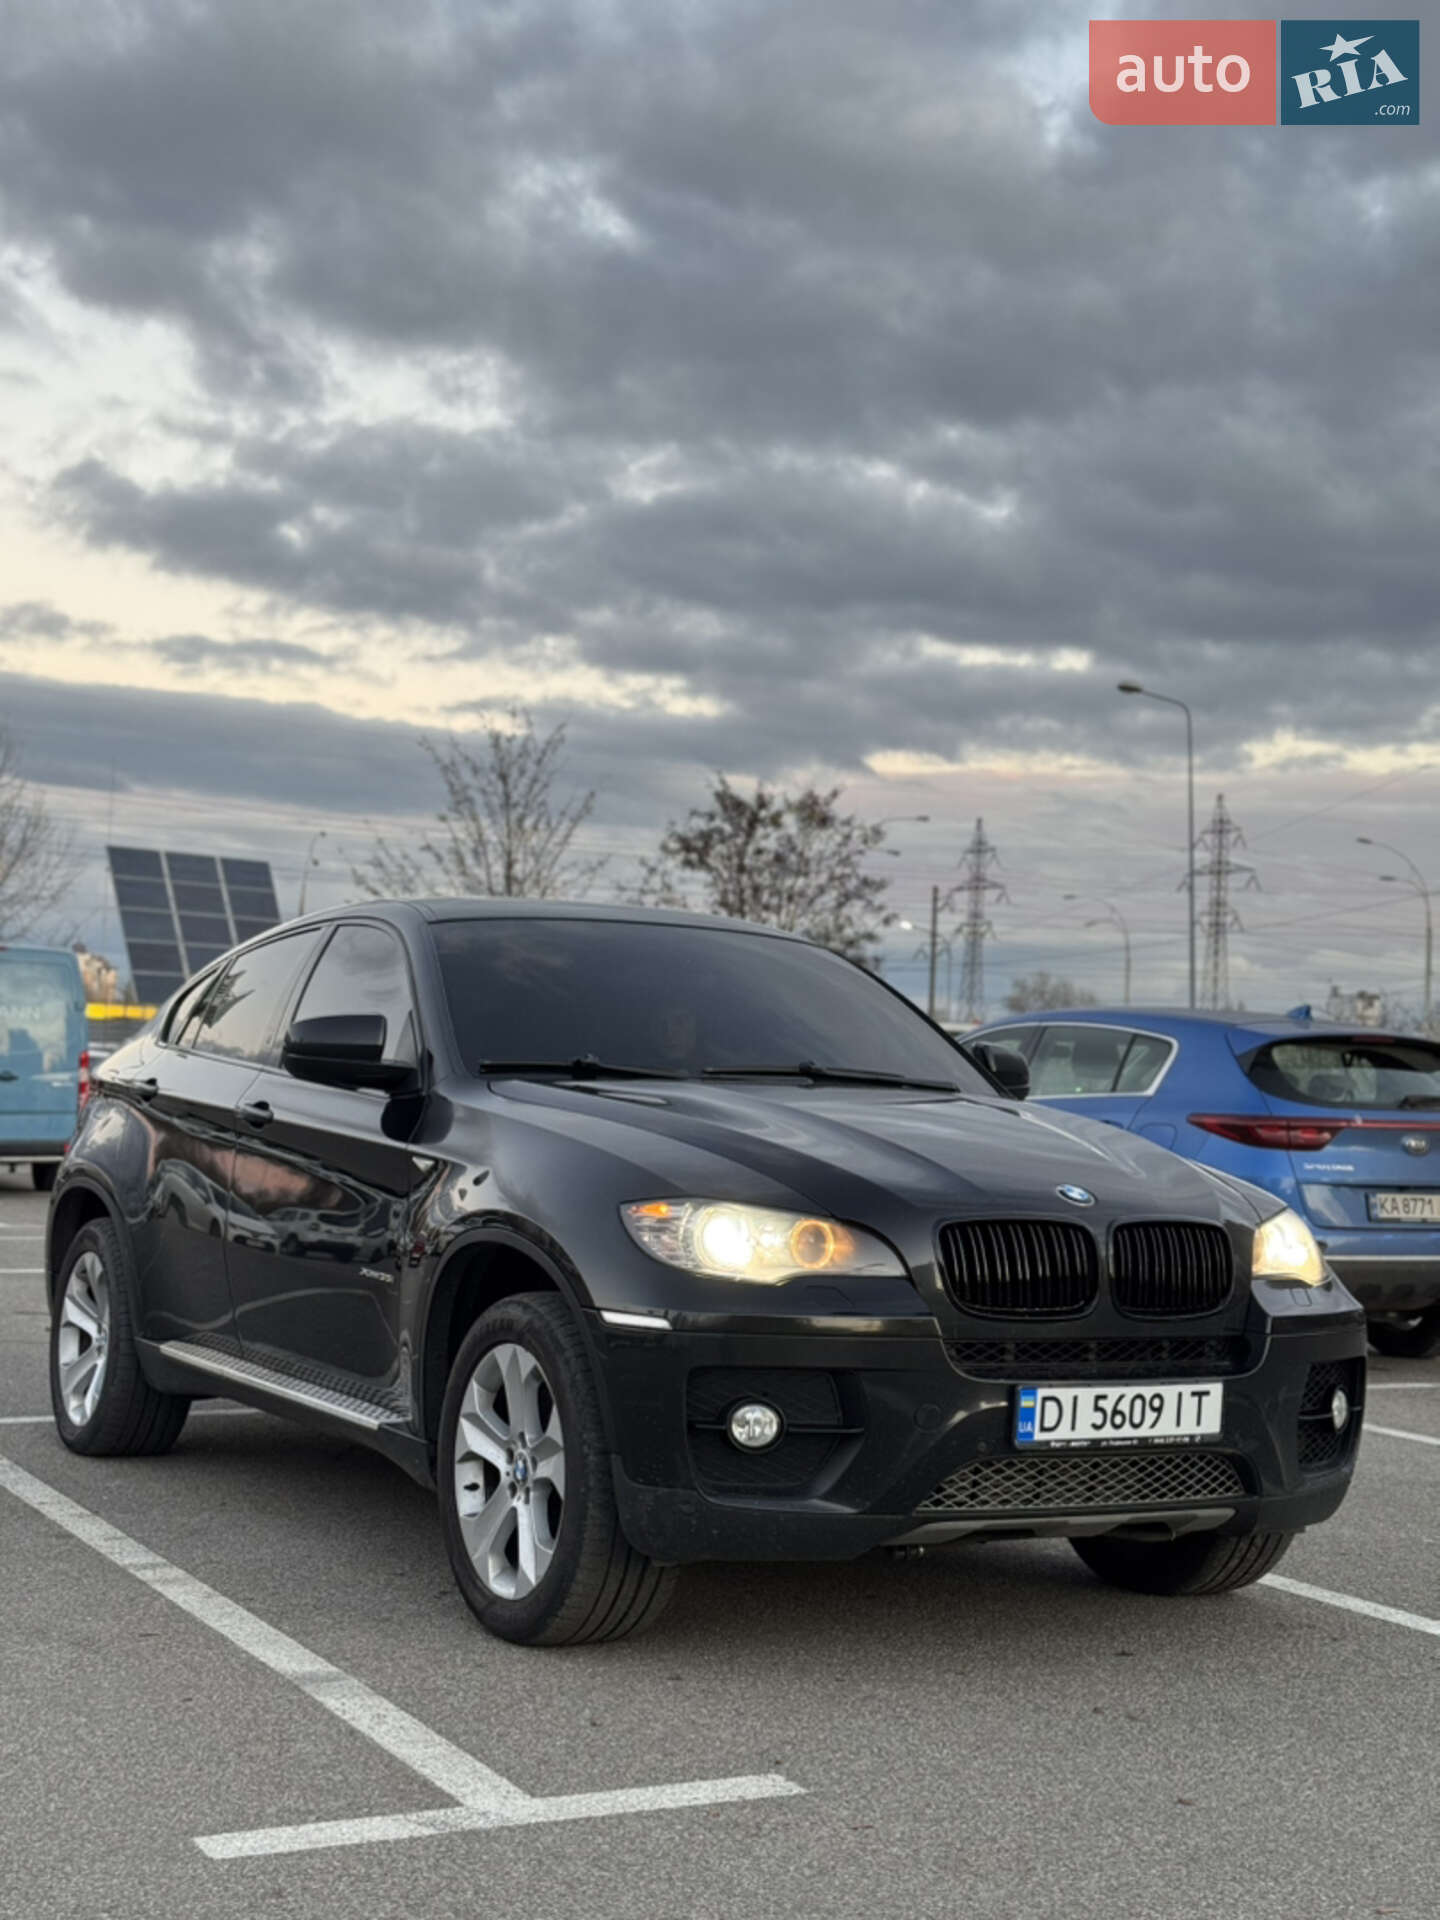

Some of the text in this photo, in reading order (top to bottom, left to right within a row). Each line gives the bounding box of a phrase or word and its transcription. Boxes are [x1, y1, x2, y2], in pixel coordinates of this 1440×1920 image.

[1039, 1390, 1210, 1432] DI 5609 IT
[1018, 1421, 1034, 1432] UA
